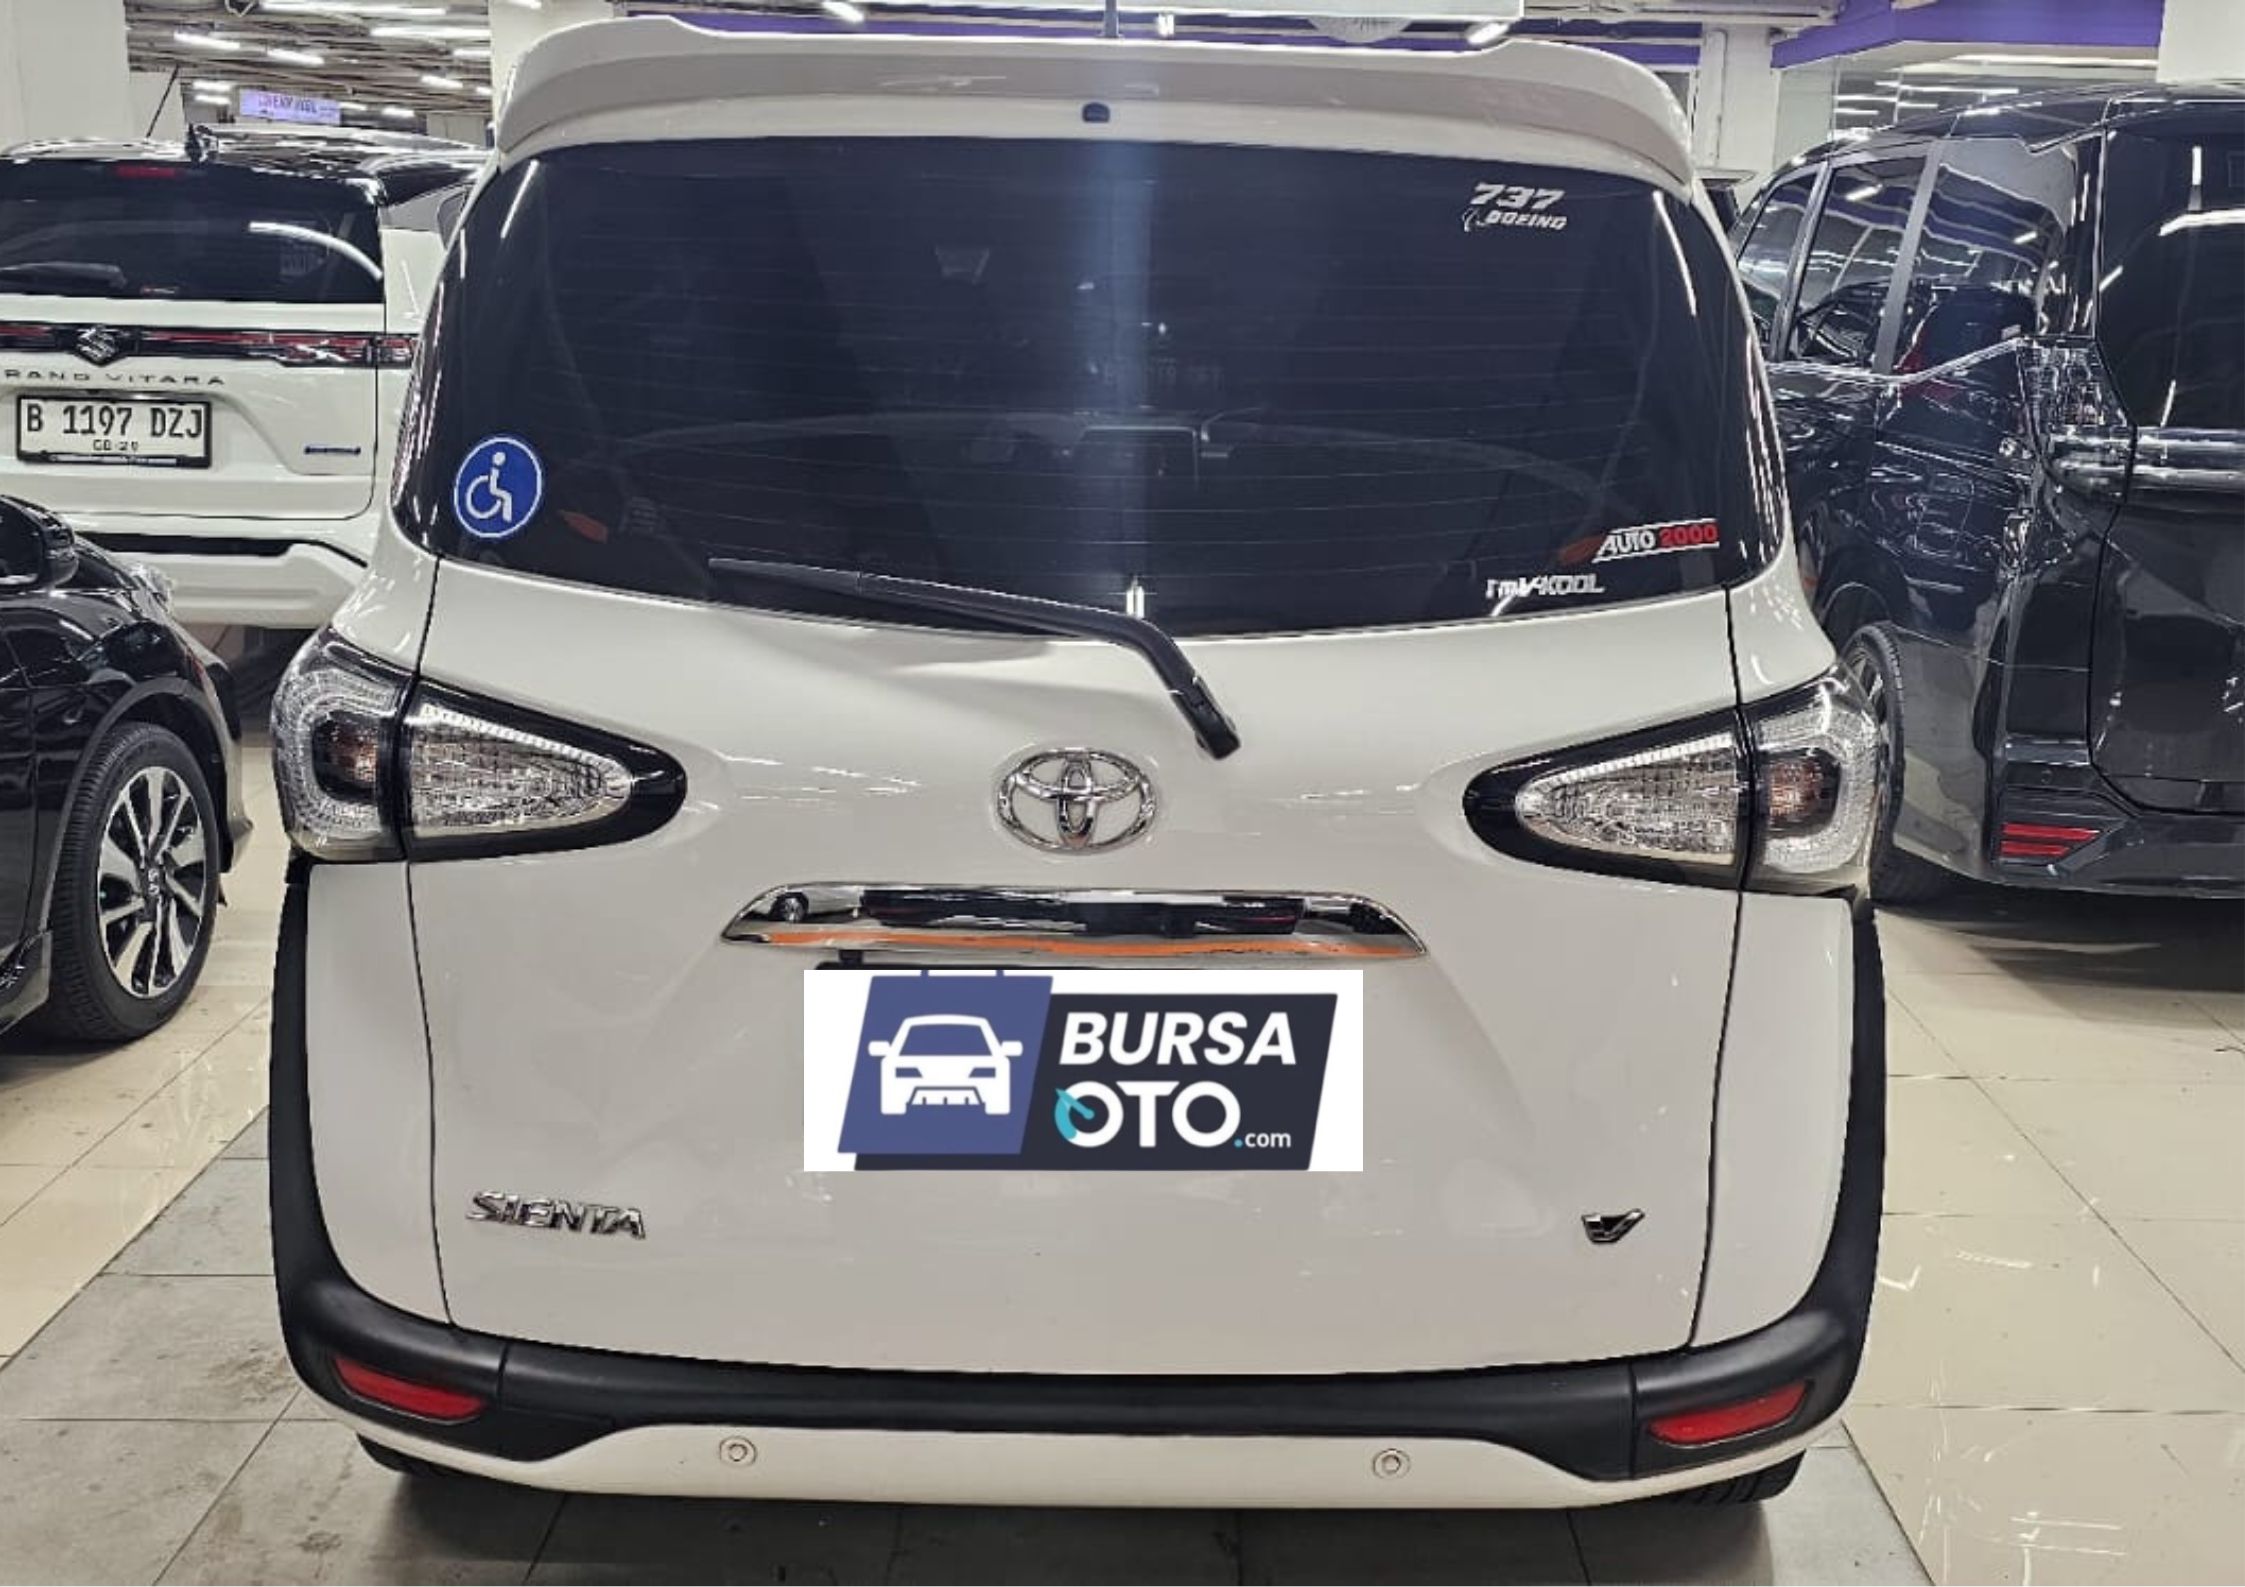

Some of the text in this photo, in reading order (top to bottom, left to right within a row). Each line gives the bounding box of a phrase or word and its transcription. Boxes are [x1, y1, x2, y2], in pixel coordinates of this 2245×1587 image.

[1470, 182, 1565, 210] 737
[1484, 210, 1568, 230] BOEING
[4, 369, 225, 386] RAND VITARA
[26, 403, 203, 439] B 1197 DZJ
[1596, 523, 1719, 557] AUTO 2000
[465, 1191, 647, 1240] SIENTA
